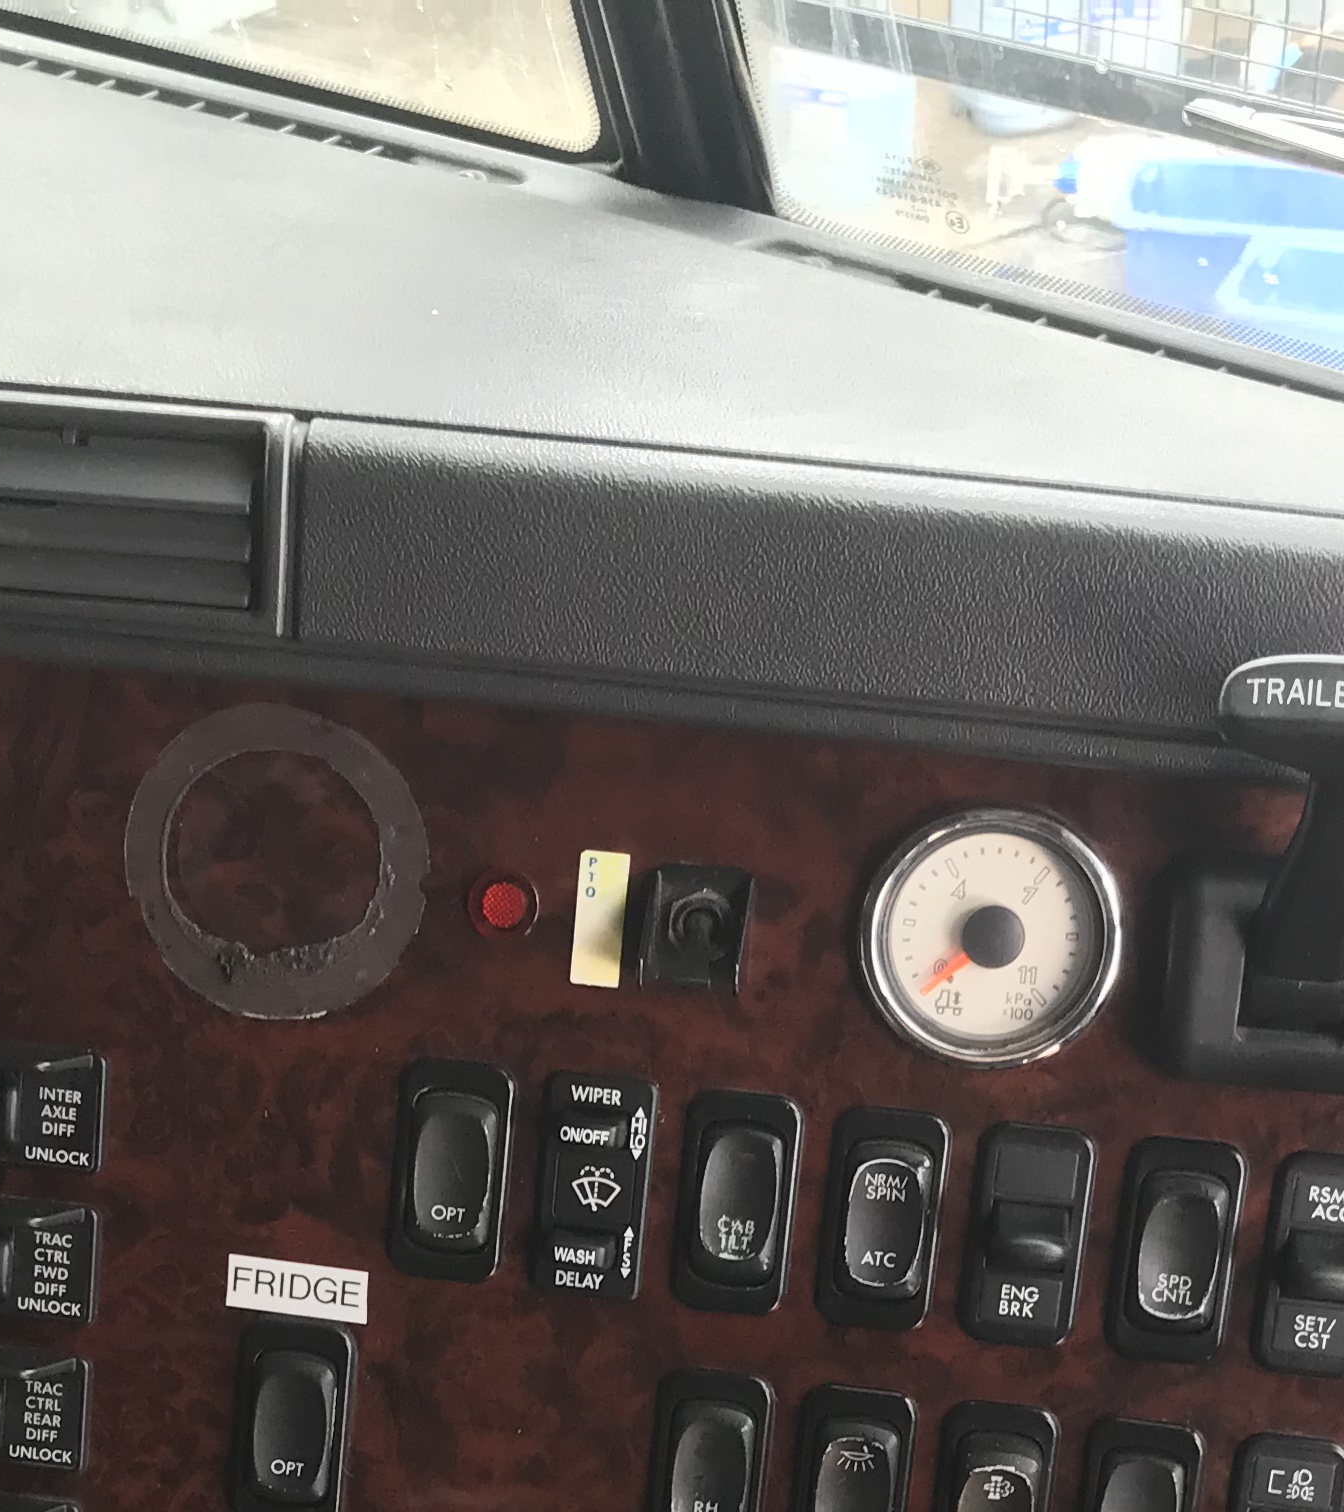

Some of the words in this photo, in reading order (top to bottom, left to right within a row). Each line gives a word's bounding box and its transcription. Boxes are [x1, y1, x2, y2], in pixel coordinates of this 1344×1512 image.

[950, 879, 967, 900] 4
[1018, 965, 1038, 986] 11
[1005, 991, 1033, 1006] kPa
[39, 1086, 82, 1104] INTER
[571, 1084, 622, 1106] WIPER
[40, 1104, 77, 1121] AXLE
[41, 1121, 76, 1138] DIFF
[630, 1117, 647, 1135] HI
[560, 1125, 610, 1146] ON/OFF
[629, 1133, 646, 1150] LO
[25, 1145, 90, 1167] UNLOCK
[865, 1185, 906, 1203] SPIN
[431, 1204, 466, 1223] OPT
[34, 1231, 73, 1248] TRAC
[623, 1236, 632, 1252] F
[34, 1248, 70, 1265] CTRL
[554, 1246, 596, 1266] WASH
[621, 1252, 631, 1268] S
[860, 1250, 897, 1268] ATC
[33, 1264, 69, 1281] FWD
[554, 1269, 604, 1290] DELAY
[1157, 1273, 1192, 1290] SPD
[34, 1281, 67, 1298] DIFF
[232, 1266, 362, 1309] FRIDGE
[1001, 1284, 1039, 1302] ENG
[1151, 1287, 1192, 1306] CNTL
[17, 1297, 82, 1317] UNLOCK
[998, 1301, 1034, 1319] BRK
[1294, 1331, 1331, 1350] CST
[25, 1380, 63, 1397] TRAC
[25, 1396, 62, 1412] CTRL
[23, 1412, 61, 1428] REAR
[25, 1428, 58, 1443] DIFF
[8, 1444, 73, 1464] UNLOCK
[270, 1458, 304, 1477] OPT
